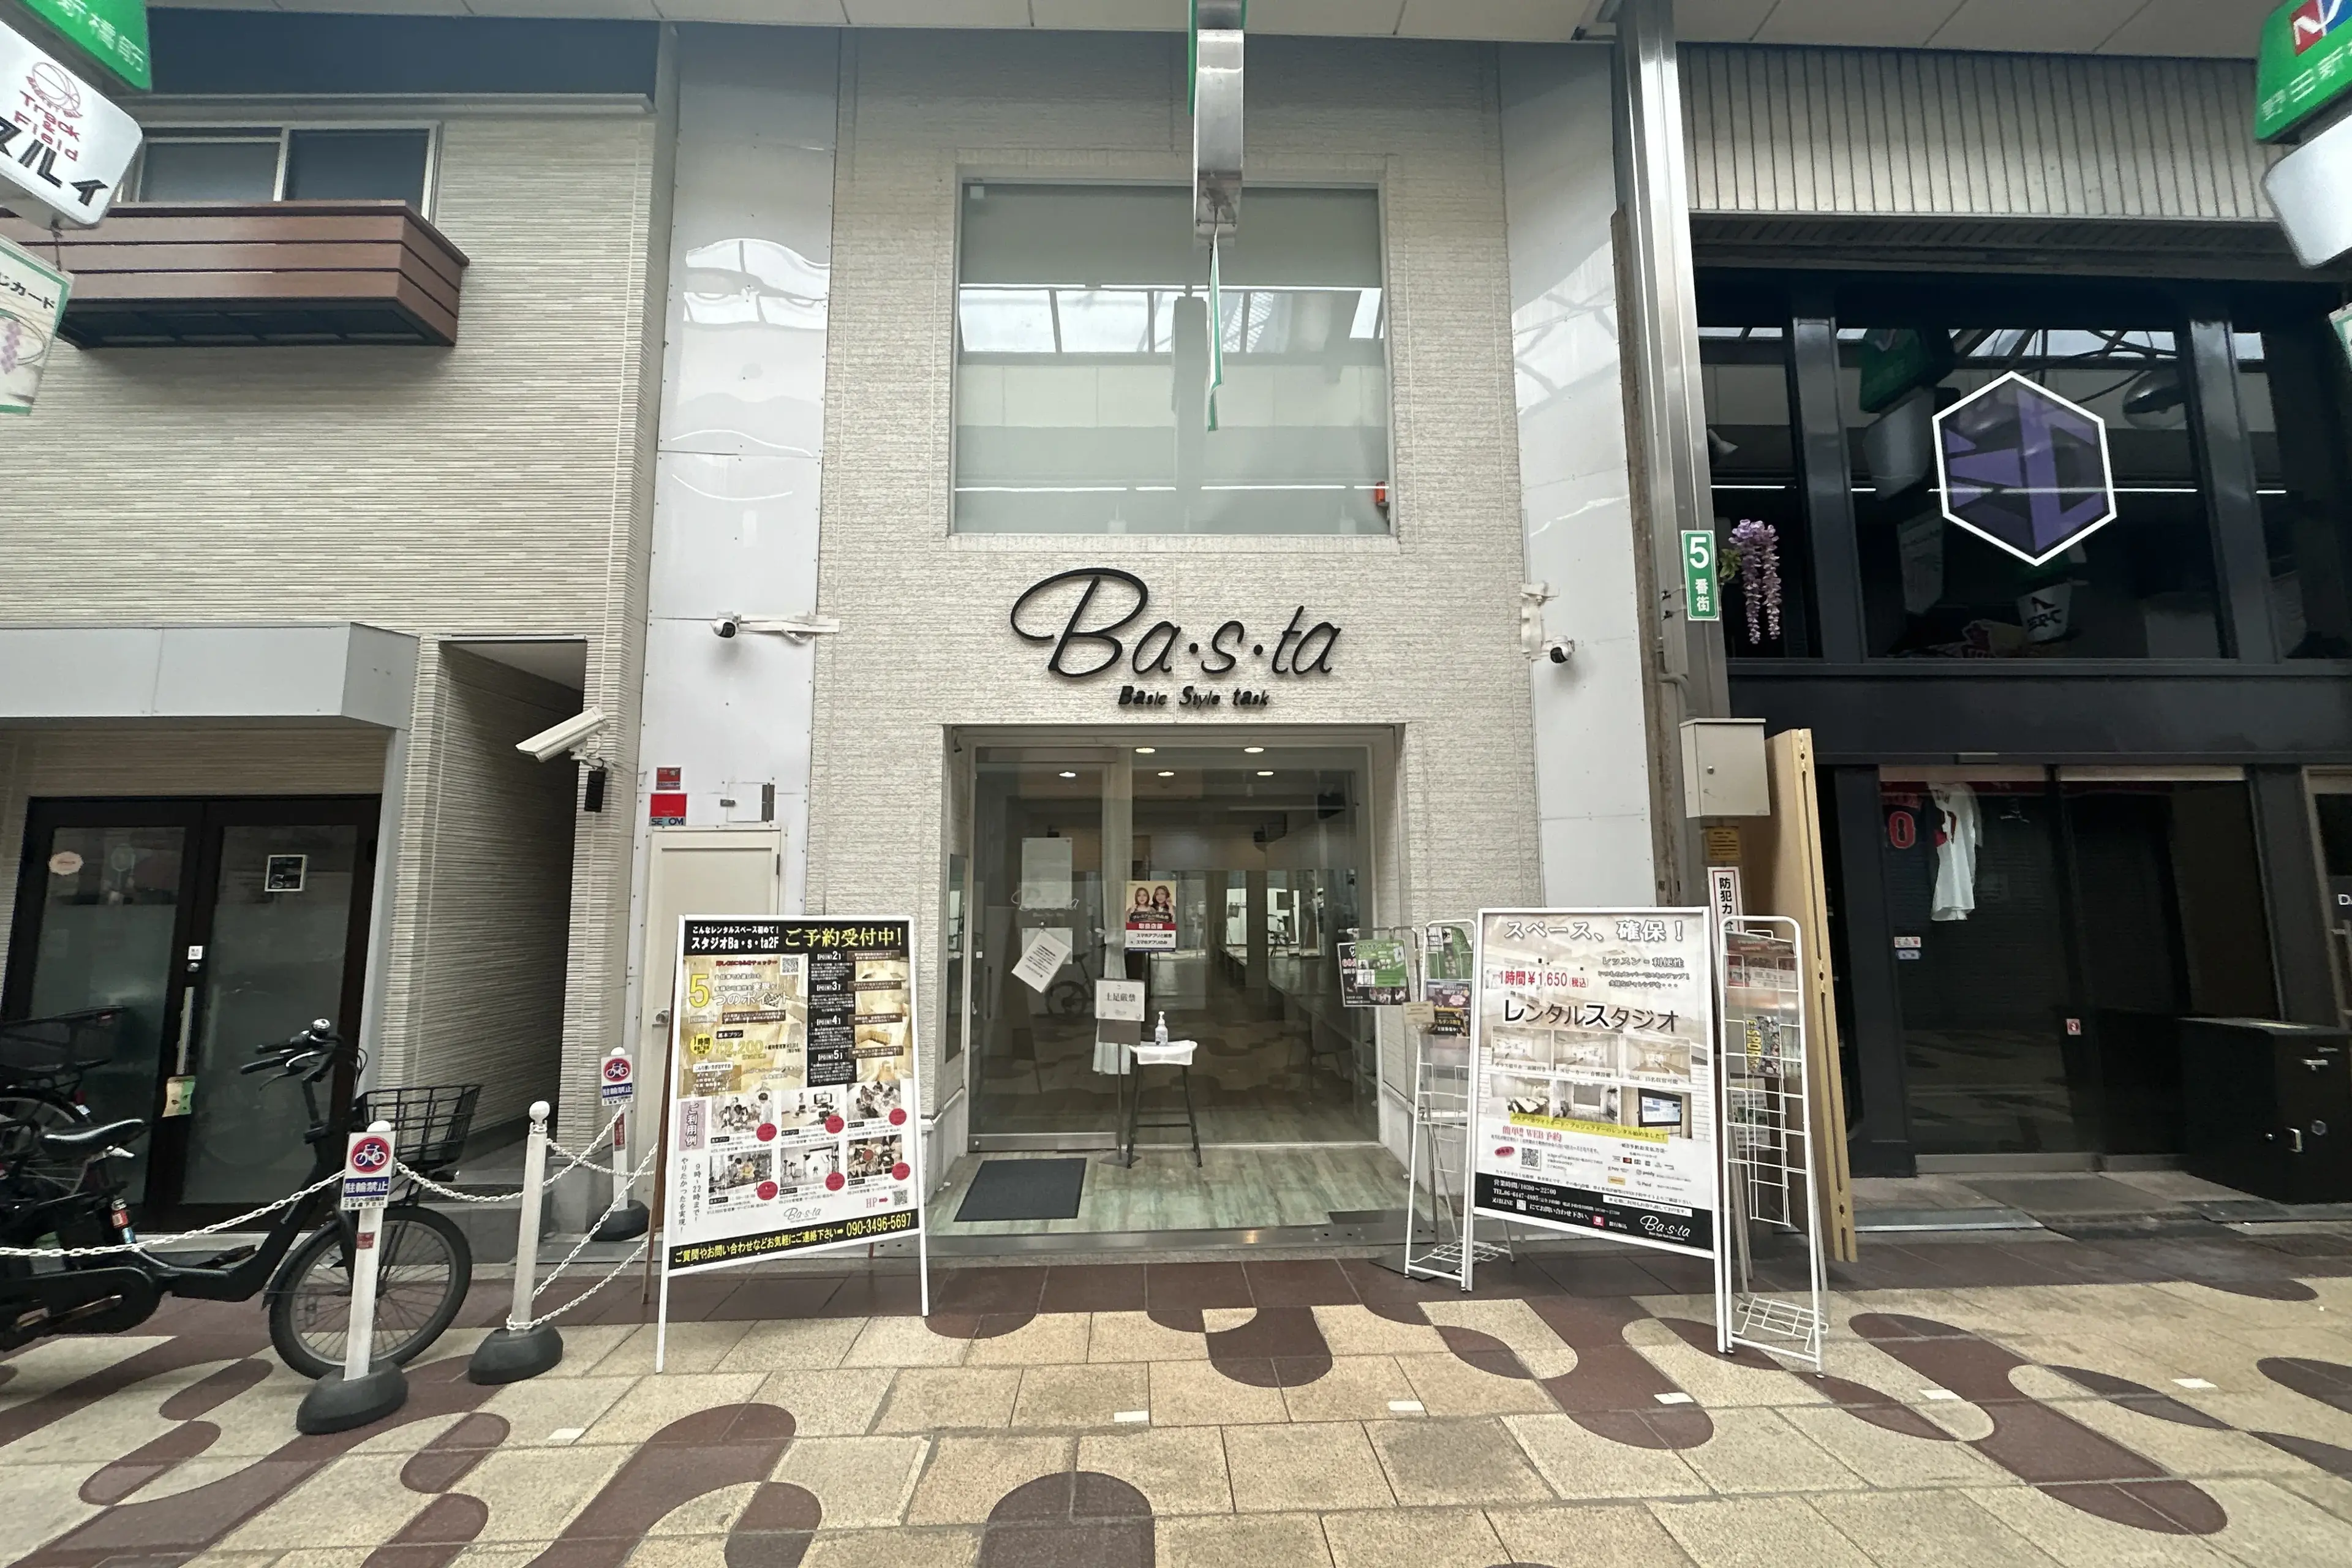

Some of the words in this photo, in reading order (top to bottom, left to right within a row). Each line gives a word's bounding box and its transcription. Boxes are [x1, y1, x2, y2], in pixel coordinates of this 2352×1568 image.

[19, 90, 80, 142] Track
[14, 110, 78, 162] Field
[1118, 685, 1167, 706] Basic
[1180, 685, 1220, 709] Style
[1233, 687, 1269, 706] task
[1504, 1000, 1679, 1032] レンタルスタジオ
[694, 1036, 710, 1046] 1時間
[685, 1103, 699, 1147] ご利用例
[1546, 1131, 1562, 1143] 予約
[345, 1180, 388, 1194] 駐輪禁止
[865, 1197, 877, 1208] HP
[846, 1213, 912, 1237] 090-3496-5697
